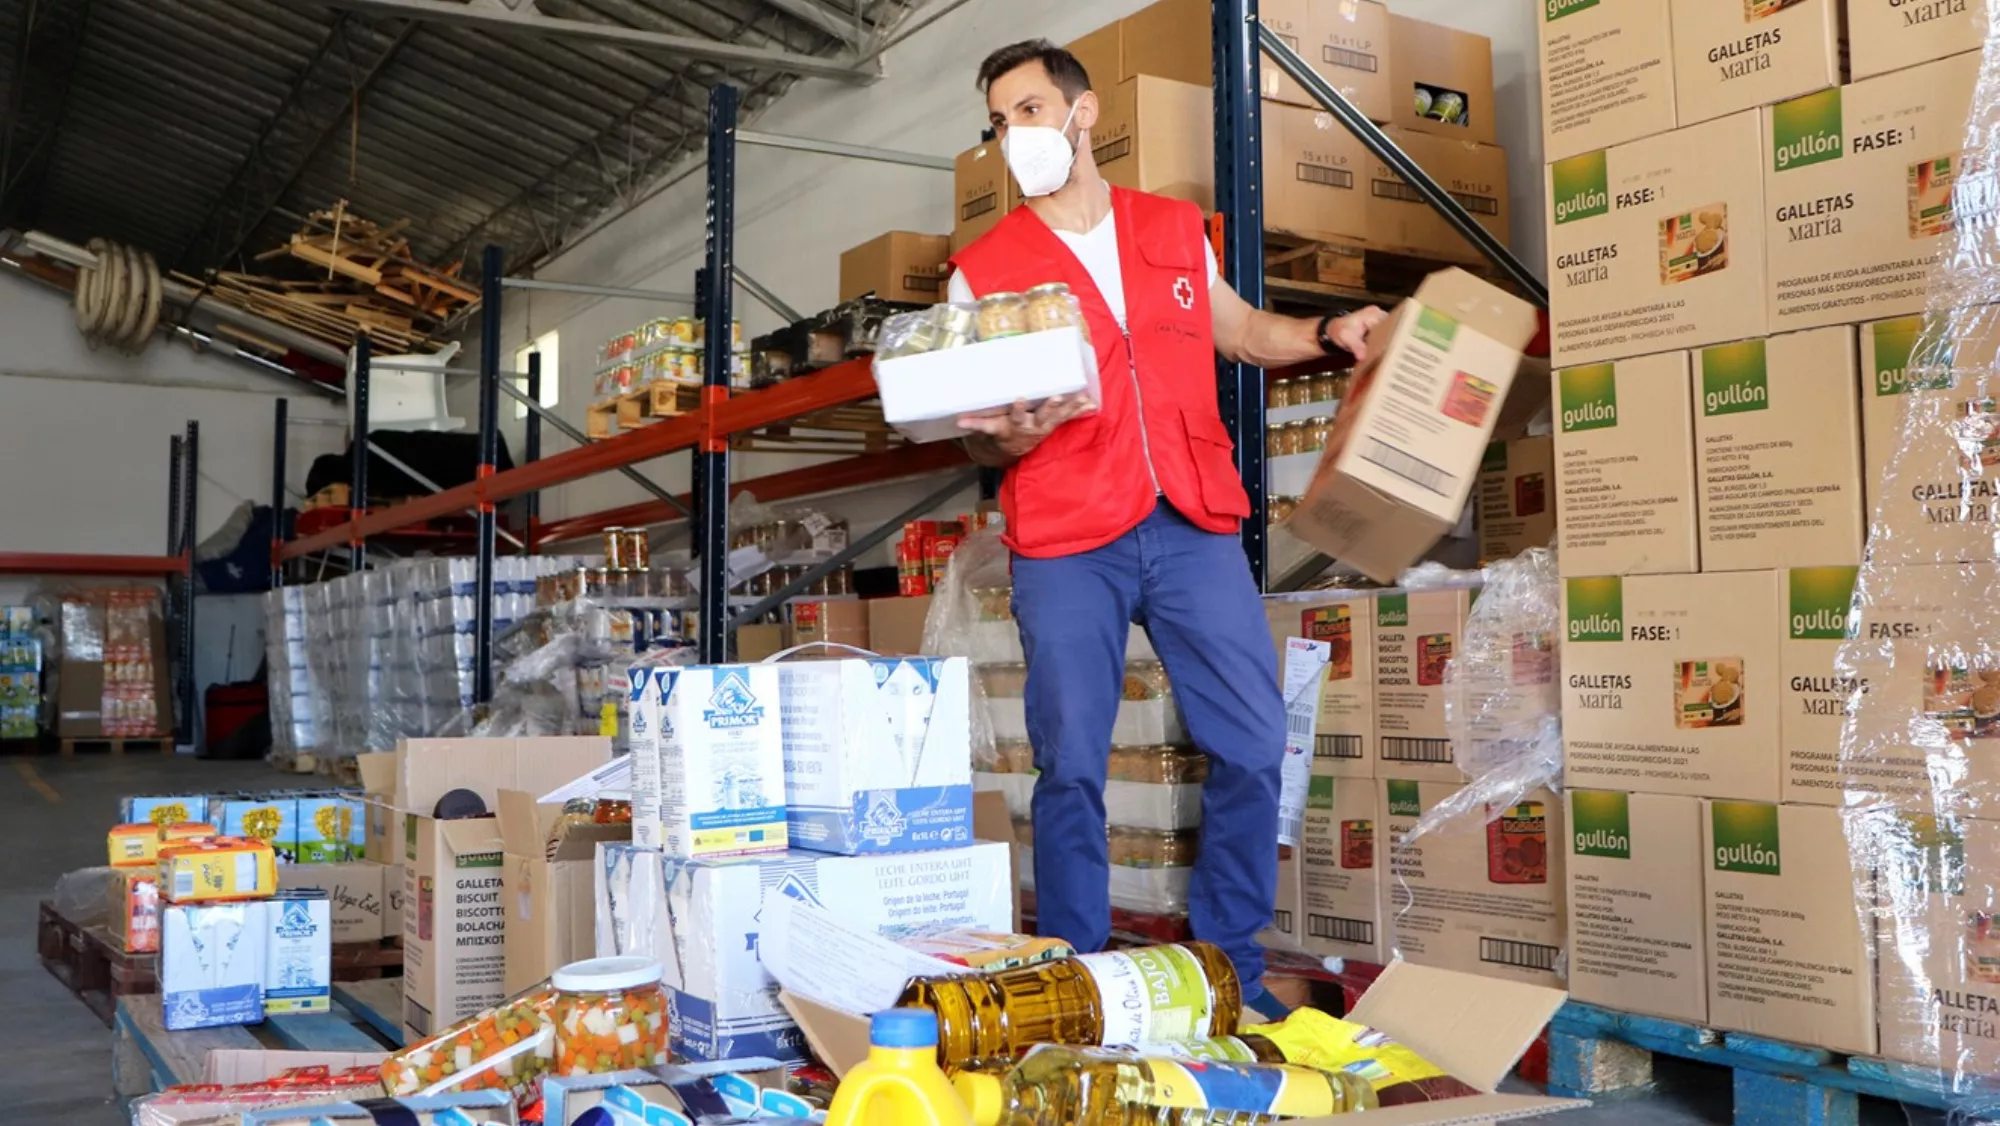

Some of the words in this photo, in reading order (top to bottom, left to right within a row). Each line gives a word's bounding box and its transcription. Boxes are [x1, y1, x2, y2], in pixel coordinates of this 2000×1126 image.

[1707, 28, 1782, 63] GALLETAS
[1719, 51, 1772, 82] María
[1777, 131, 1841, 167] gullón
[1852, 129, 1903, 154] FASE:
[1910, 126, 1916, 141] 1
[1556, 189, 1607, 221] gullón
[1616, 188, 1655, 209] FASE:
[1660, 186, 1665, 198] 1
[1776, 193, 1855, 223] GALLETAS
[1788, 215, 1842, 243] María
[1556, 244, 1618, 270] GALLETAS
[1566, 262, 1609, 288] María
[1777, 274, 1819, 289] PROGRAMA
[1819, 273, 1832, 282] DE
[1832, 268, 1860, 280] AYUDA
[1860, 259, 1915, 275] ALIMENTARIA
[1916, 258, 1924, 266] A
[1777, 288, 1817, 302] PERSONAS
[1835, 273, 1905, 292] DESFAVORECIDAS
[1905, 271, 1926, 283] 2021
[1557, 315, 1593, 328] PROGRAMA
[1594, 313, 1601, 322] DE
[1672, 299, 1686, 309] LAS
[1778, 303, 1822, 317] ALIMENTOS
[1822, 295, 1865, 311] GRATUITOS
[1706, 380, 1766, 412] gullón
[1563, 400, 1615, 429] gullón
[1927, 503, 1989, 525] Maa
[1379, 609, 1407, 625] gullón
[1570, 612, 1621, 639] gullón
[1378, 634, 1406, 642] GALLETA
[1631, 625, 1671, 641] FASE:
[1675, 626, 1681, 640] 1
[1378, 645, 1403, 653] BISCUIT
[1378, 656, 1409, 665] BISCOTTO
[1378, 667, 1409, 675] BOLACHA
[1568, 674, 1632, 690] GALLETAS
[1579, 690, 1624, 709] María
[1802, 694, 1852, 717] Marí
[1570, 741, 1604, 750] PROGRAMA
[1604, 741, 1613, 750] DE
[1613, 742, 1636, 752] AYUDA
[1636, 744, 1681, 754] ALIMENTARIA
[1680, 745, 1687, 754] A
[1687, 746, 1700, 755] LAS
[1790, 750, 1832, 761] PROGRAMA
[1672, 756, 1689, 765] 2021
[1390, 801, 1420, 814] gullón
[1390, 846, 1423, 856] BIOTTO
[1576, 829, 1629, 852] gullón
[1716, 843, 1778, 867] gullón
[875, 865, 906, 877] LECHE
[909, 861, 949, 874] ENTERA
[951, 857, 972, 869] UHT
[456, 879, 504, 890] GALLETA
[878, 877, 906, 890] LEITE
[908, 873, 947, 887] GORDO
[949, 870, 970, 882] UHT
[456, 893, 498, 904] BISCUIT
[883, 896, 906, 907] Origen
[943, 888, 969, 900] Portugal
[939, 900, 966, 913] Portugal
[456, 921, 505, 933] BOLACHA
[456, 934, 505, 947] ΜΠΙΣΚΟΤ
[1132, 950, 1171, 1007] BAJO
[1934, 988, 2000, 1015] ALLETA
[1938, 1014, 1996, 1039] aría
